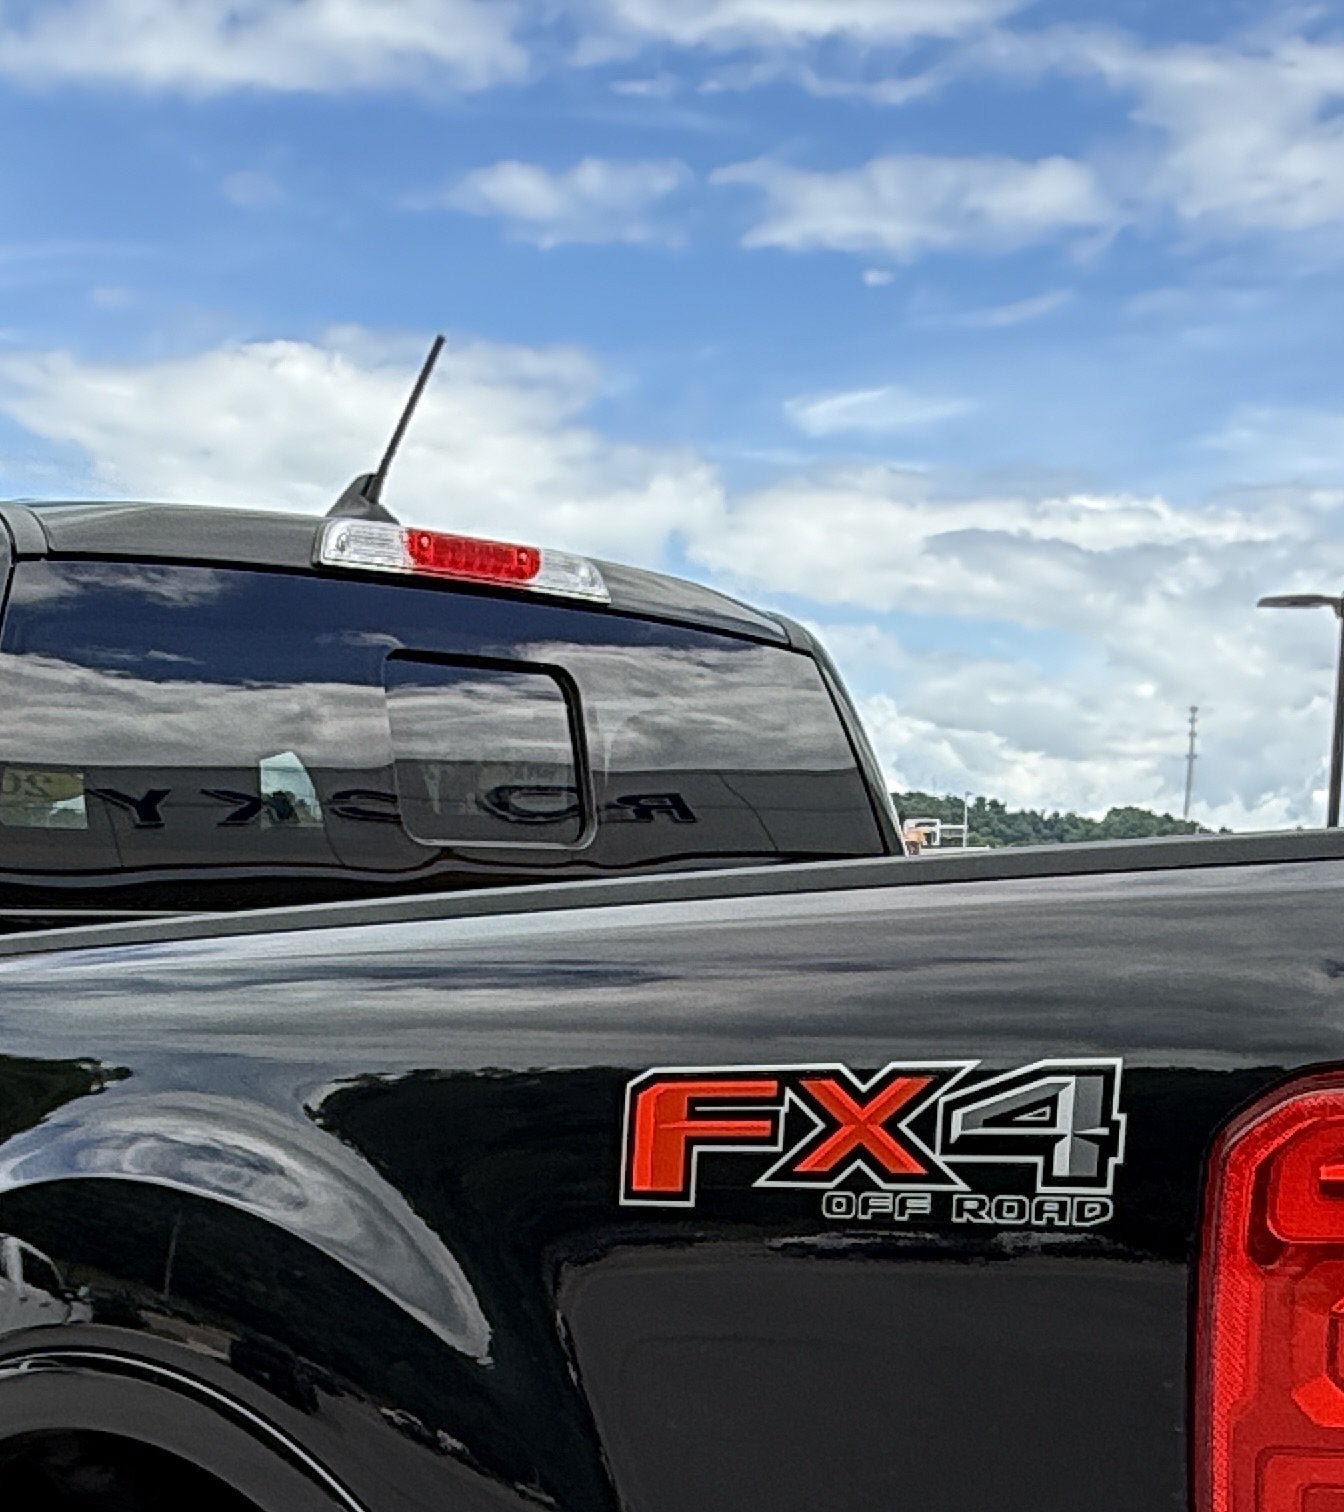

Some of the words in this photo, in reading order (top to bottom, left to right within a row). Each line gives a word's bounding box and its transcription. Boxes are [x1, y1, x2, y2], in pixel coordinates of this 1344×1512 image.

[620, 1058, 1127, 1207] FX4
[821, 1191, 932, 1220] OFF
[952, 1193, 1114, 1227] ROAD
